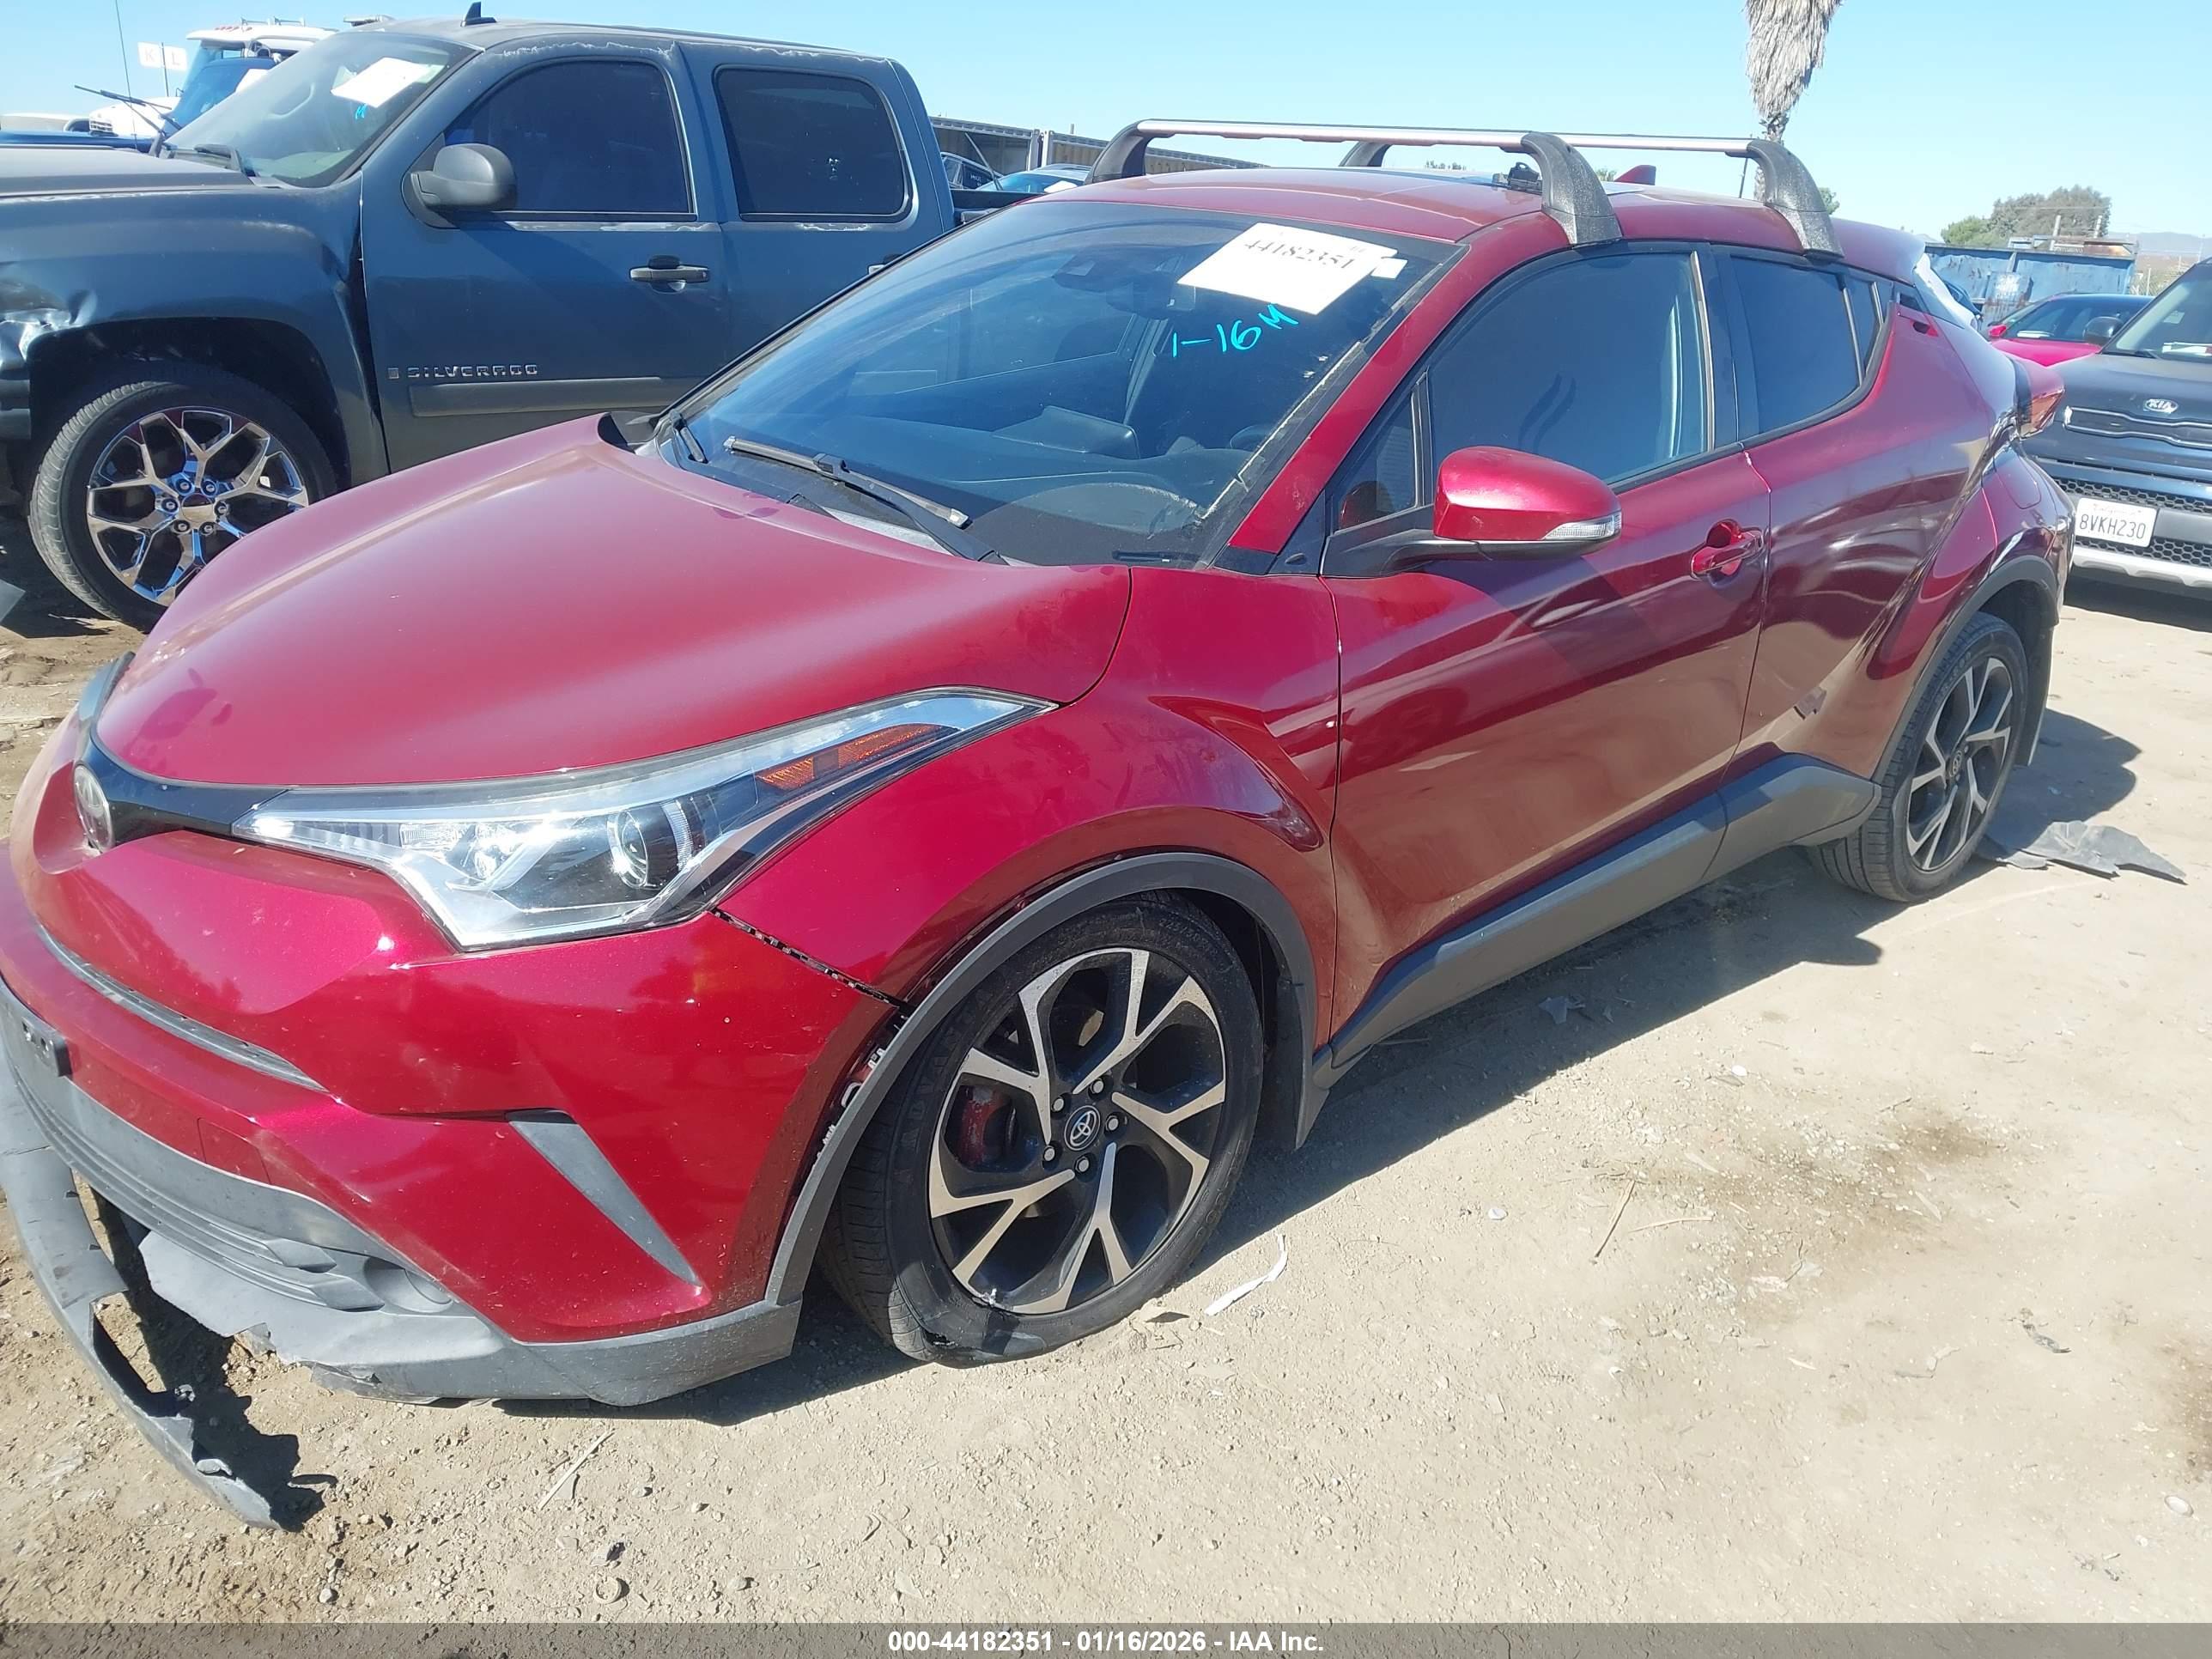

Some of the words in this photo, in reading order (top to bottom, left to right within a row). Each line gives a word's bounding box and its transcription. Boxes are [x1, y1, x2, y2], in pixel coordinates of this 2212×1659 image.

[1172, 319, 1262, 358] 1-16
[407, 364, 538, 379] SILVERADO
[2148, 398, 2172, 410] KIA
[2079, 514, 2147, 540] 8VKH230
